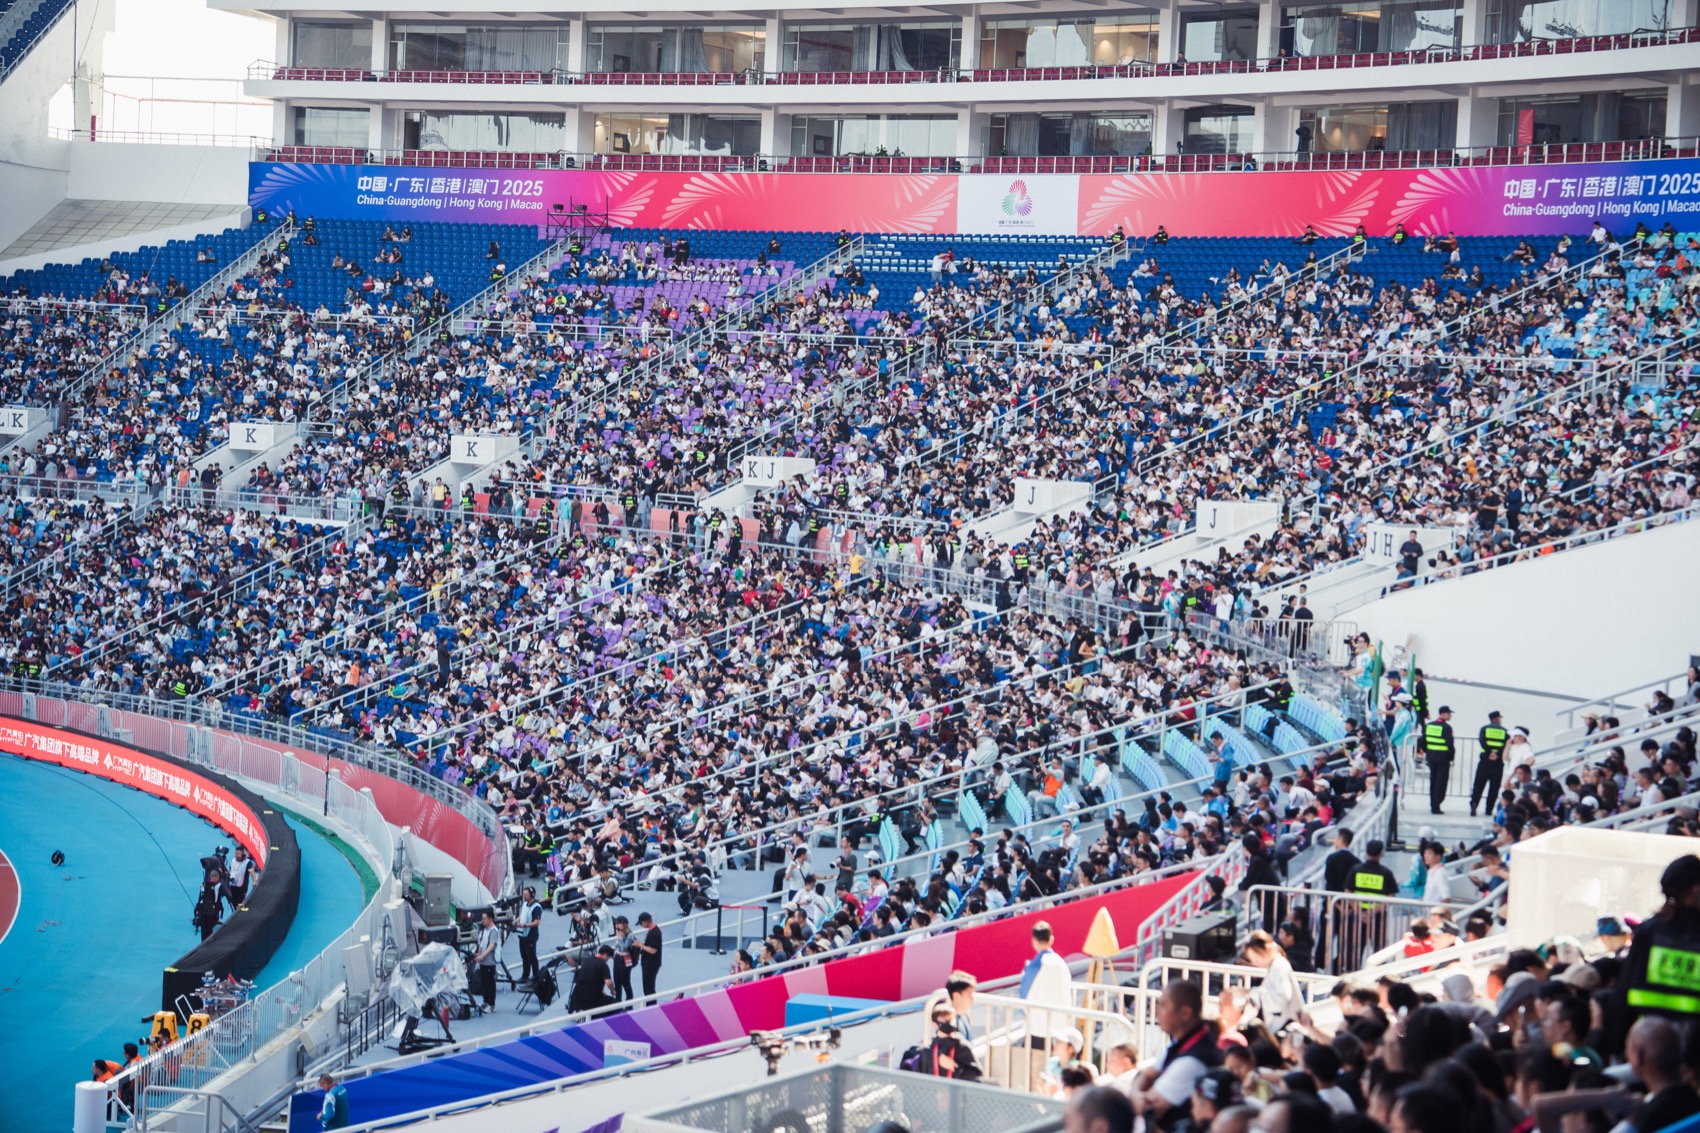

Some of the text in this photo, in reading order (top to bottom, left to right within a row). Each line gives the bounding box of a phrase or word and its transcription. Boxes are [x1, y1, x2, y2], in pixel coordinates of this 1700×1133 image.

[502, 179, 544, 196] 2025
[1658, 173, 1700, 195] 2025
[449, 197, 475, 210] Hong
[478, 198, 503, 211] Kong
[510, 199, 543, 210] Macao
[1603, 202, 1631, 217] Hong
[1633, 200, 1660, 217] Kong
[11, 412, 24, 428] K
[245, 427, 257, 443] K
[466, 441, 478, 457] K
[747, 460, 775, 479] K J
[1027, 486, 1035, 505] J
[1209, 508, 1217, 529] J
[1370, 531, 1393, 557] J H
